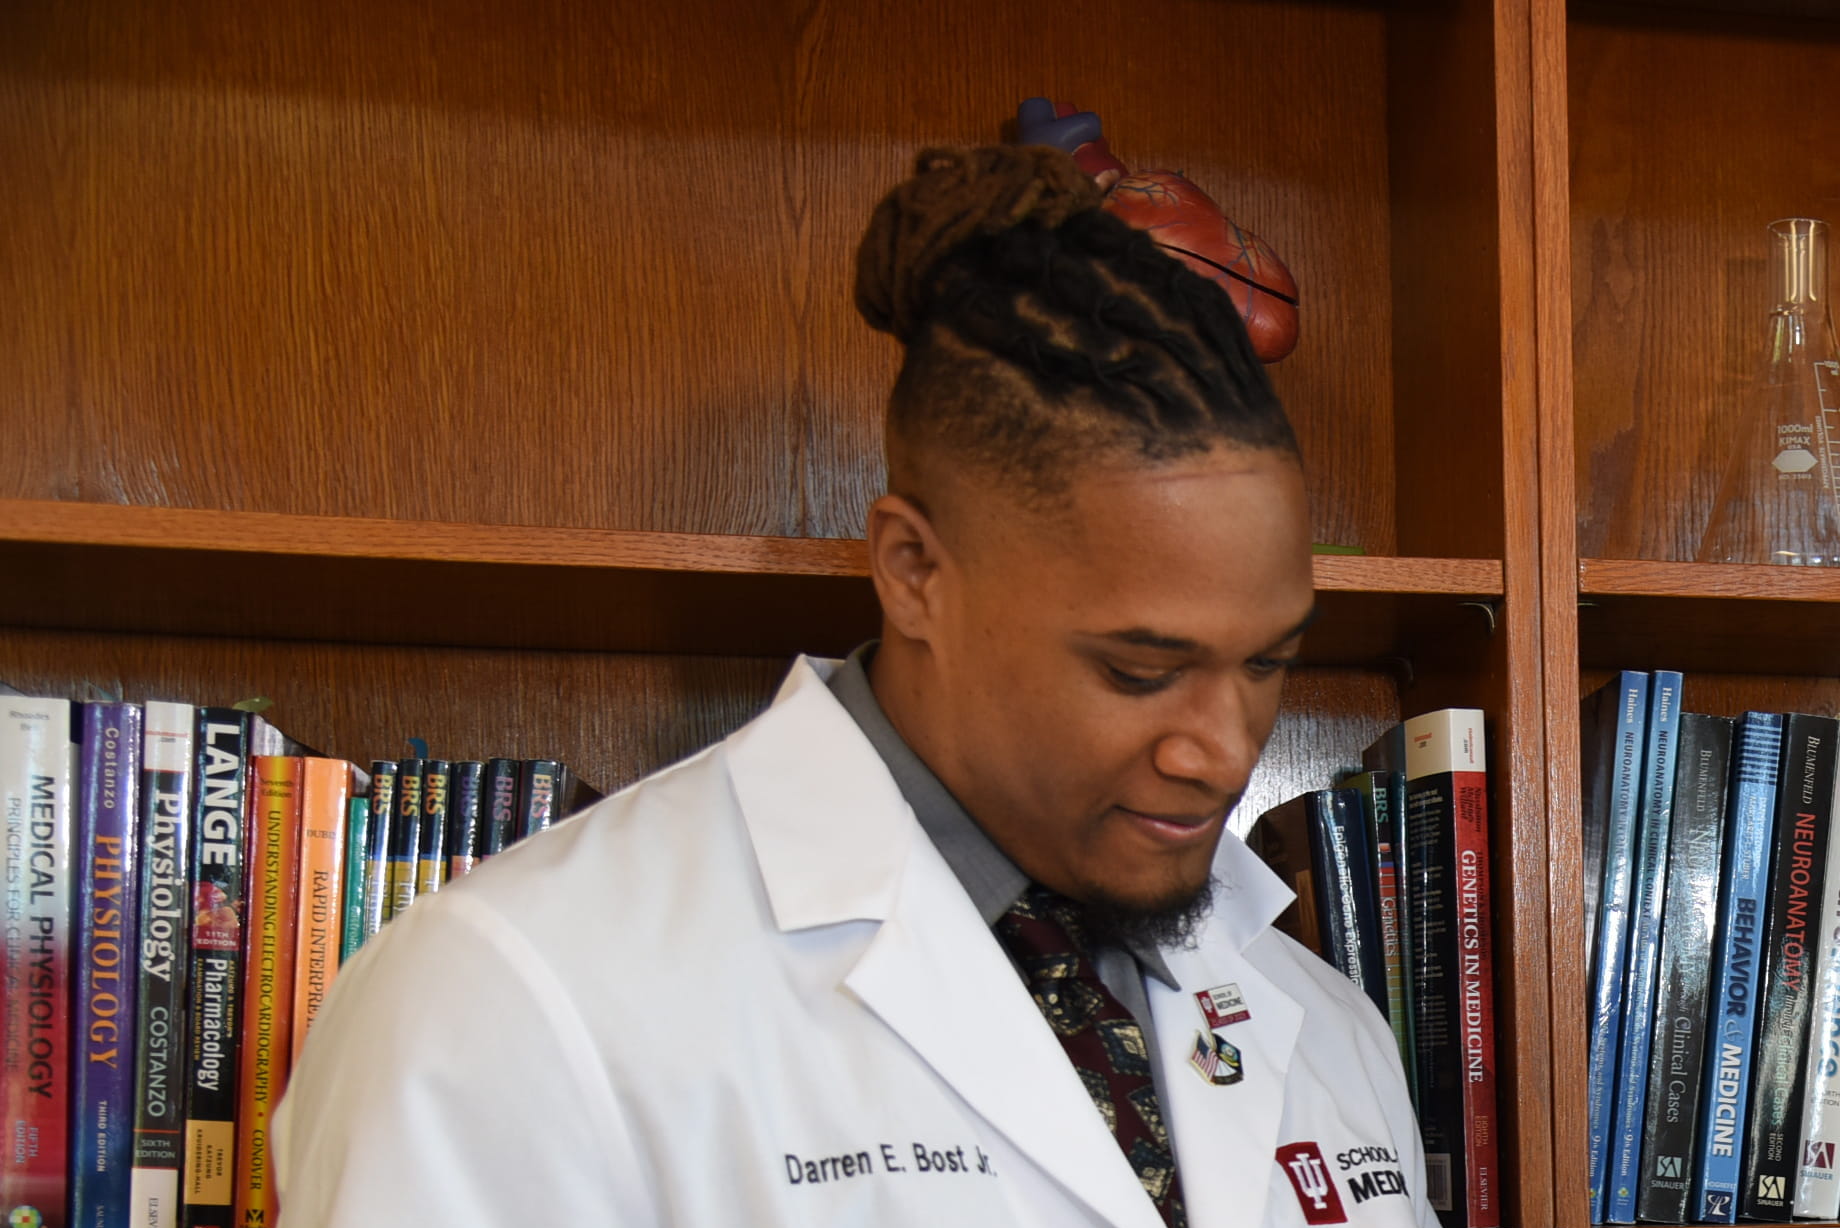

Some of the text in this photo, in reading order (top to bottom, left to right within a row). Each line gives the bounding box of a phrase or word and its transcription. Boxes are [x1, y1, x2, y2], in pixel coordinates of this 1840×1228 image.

[1777, 423, 1813, 435] 1000ml
[1778, 436, 1811, 447] KIMAX
[1626, 688, 1639, 724] Haines
[1660, 687, 1673, 723] Haines
[103, 727, 120, 810] Costanzo
[1619, 731, 1634, 815] NEUROANATOMY
[1696, 749, 1713, 812] BLUMENFELD
[1801, 735, 1821, 805] BLUMENFELD
[203, 723, 241, 866] LANGE
[373, 773, 393, 815] BRS
[401, 775, 419, 817] BRS
[425, 773, 447, 816] BRS
[492, 776, 514, 823] BRS
[531, 773, 552, 819] BRS
[1374, 787, 1389, 824] BRS
[142, 790, 184, 983] Physiology
[1782, 812, 1817, 992] NEUROANATOMY
[27, 775, 55, 1098] MEDICAL PHYSIOLOGY
[1381, 897, 1398, 958] Genetics
[89, 834, 123, 1070] PHYSIOLOGY
[253, 809, 281, 1104] UNDERSTANDING ELECTROCARDIOGRAPHY
[1460, 849, 1484, 1083] GENETICS IN MEDICINE
[1724, 896, 1757, 1020] BEHAVIOR
[196, 958, 229, 1092] Pharmacology
[1669, 1015, 1692, 1076] Clinical
[147, 1006, 170, 1118] COSTANZO
[1666, 1079, 1687, 1124] Cases
[1711, 1042, 1744, 1159] MEDICINE
[15, 1120, 26, 1164] EDITION
[28, 1126, 39, 1158] FIFTH
[251, 1129, 265, 1190] CONOVER
[784, 1149, 873, 1185] Darren
[879, 1143, 907, 1173] E.
[912, 1141, 969, 1173] Bost
[1336, 1145, 1398, 1171] SCHOOL
[1767, 1132, 1776, 1161] EDITION
[1775, 1133, 1783, 1162] SECOND
[1479, 1166, 1489, 1211] ELSEVIER
[1650, 1179, 1685, 1191] SINAUER
[1756, 1199, 1784, 1208] SINAUER
